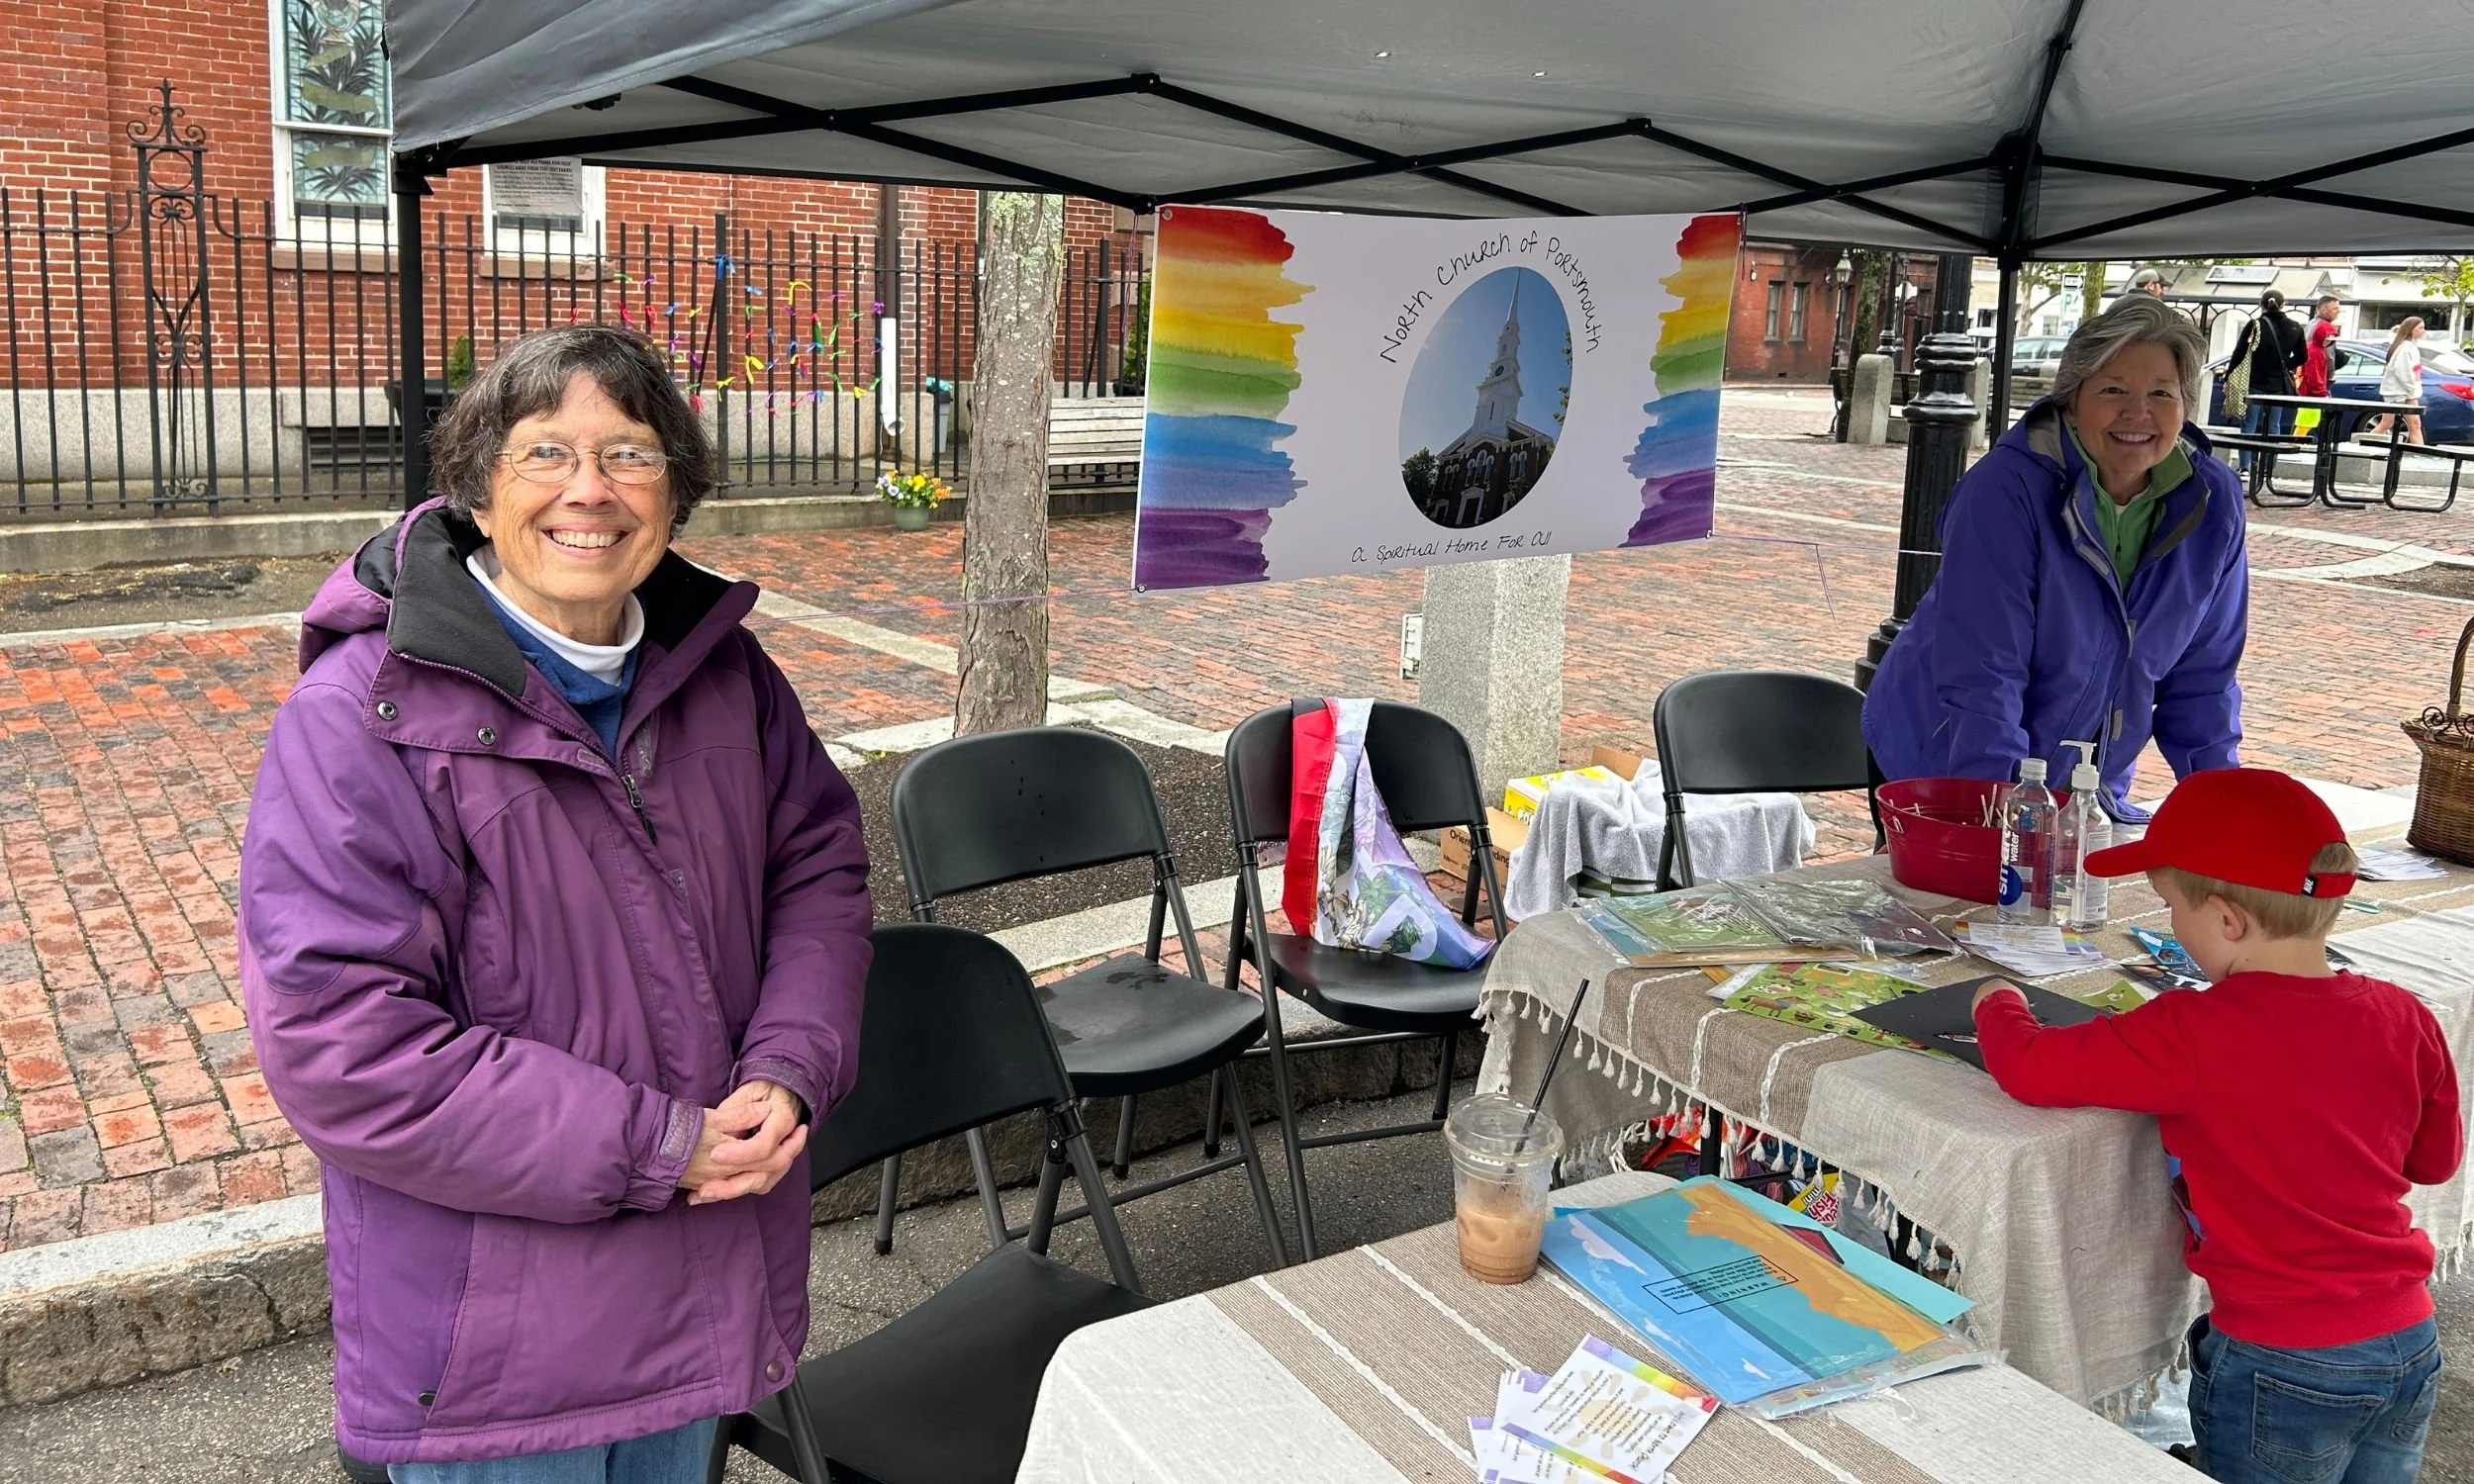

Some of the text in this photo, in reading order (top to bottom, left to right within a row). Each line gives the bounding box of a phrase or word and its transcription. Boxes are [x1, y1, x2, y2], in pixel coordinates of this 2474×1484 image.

[1380, 230, 1602, 363] North Church of Portsmouth
[1377, 540, 1440, 565] Spiritual
[1445, 538, 1488, 554] Home
[1496, 534, 1524, 549] For
[2010, 831, 2021, 863] water
[1802, 1186, 1821, 1204] mini
[1808, 1190, 1839, 1218] Fish
[1715, 1280, 1770, 1298] WARNING:
